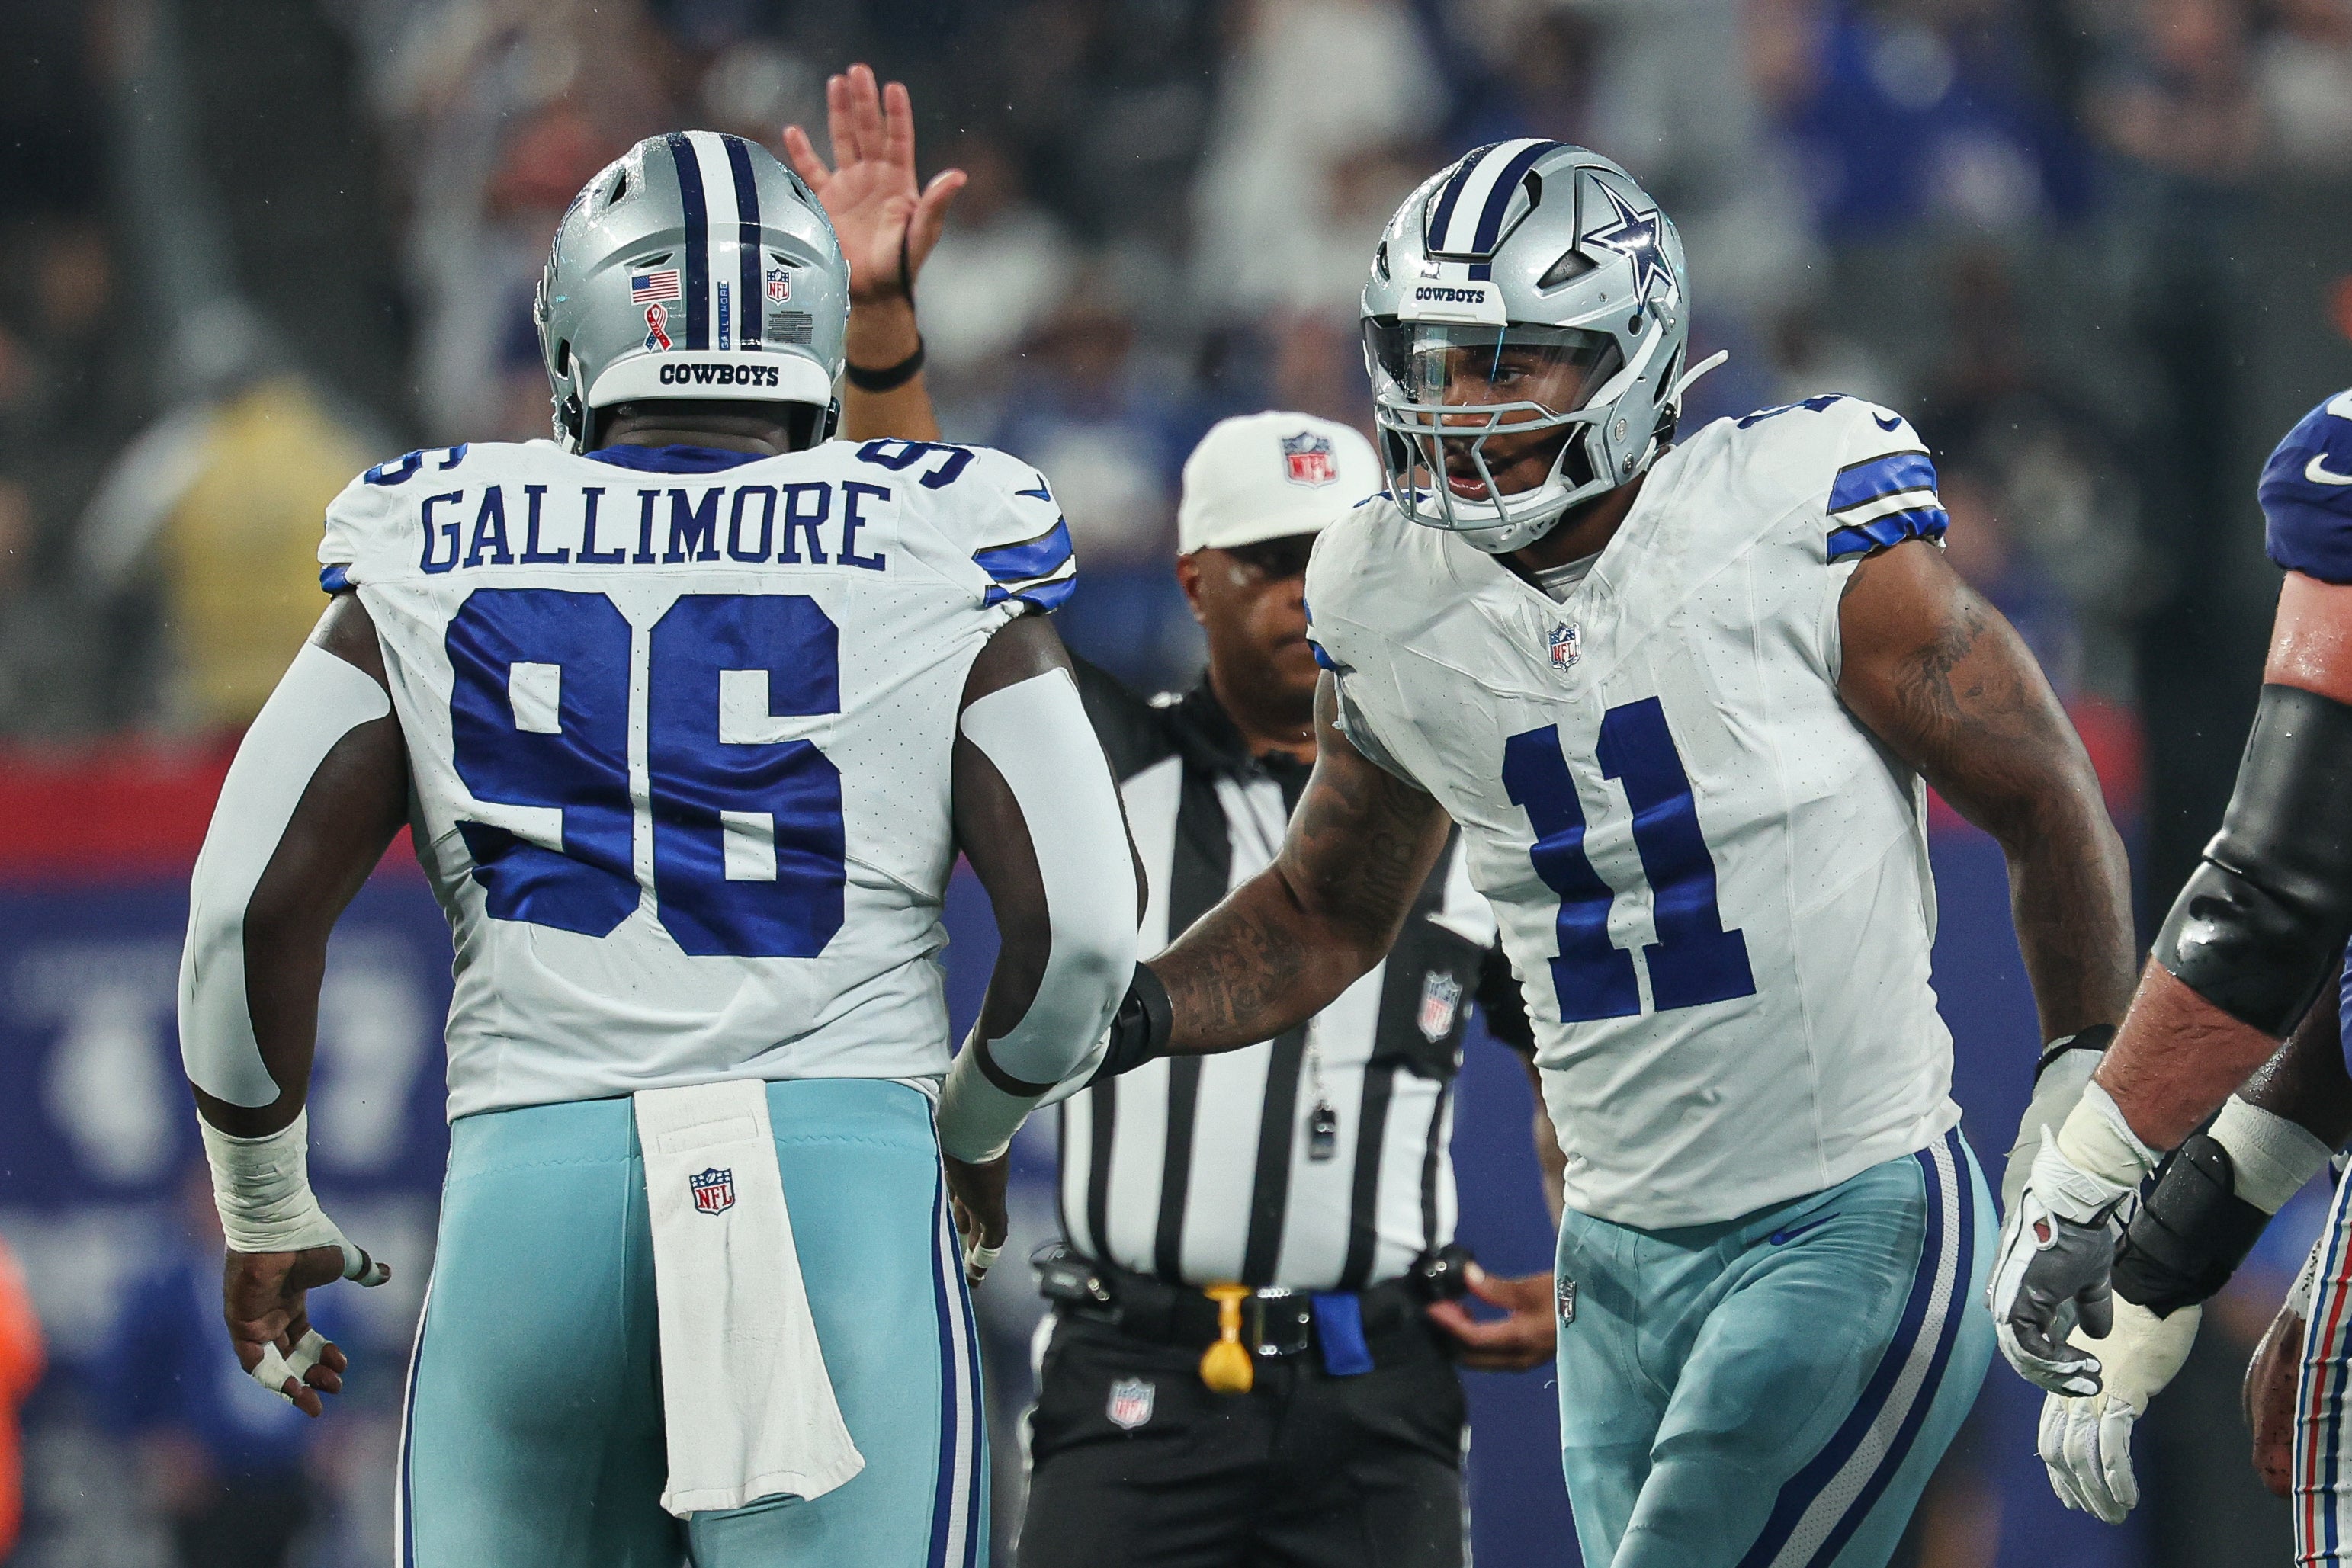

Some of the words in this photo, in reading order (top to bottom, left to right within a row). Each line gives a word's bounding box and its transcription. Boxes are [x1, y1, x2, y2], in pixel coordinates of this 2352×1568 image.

[768, 282, 789, 299] NFL
[1416, 287, 1485, 303] COWBOYS
[720, 280, 730, 349] GALLIMORE
[650, 321, 663, 338] 9/11
[659, 364, 779, 387] COWBOYS
[419, 481, 891, 575] GALLIMORE
[1553, 643, 1577, 662] NFL
[446, 587, 846, 959] 96
[1501, 695, 1757, 1024] 11
[695, 1184, 733, 1210] NFL
